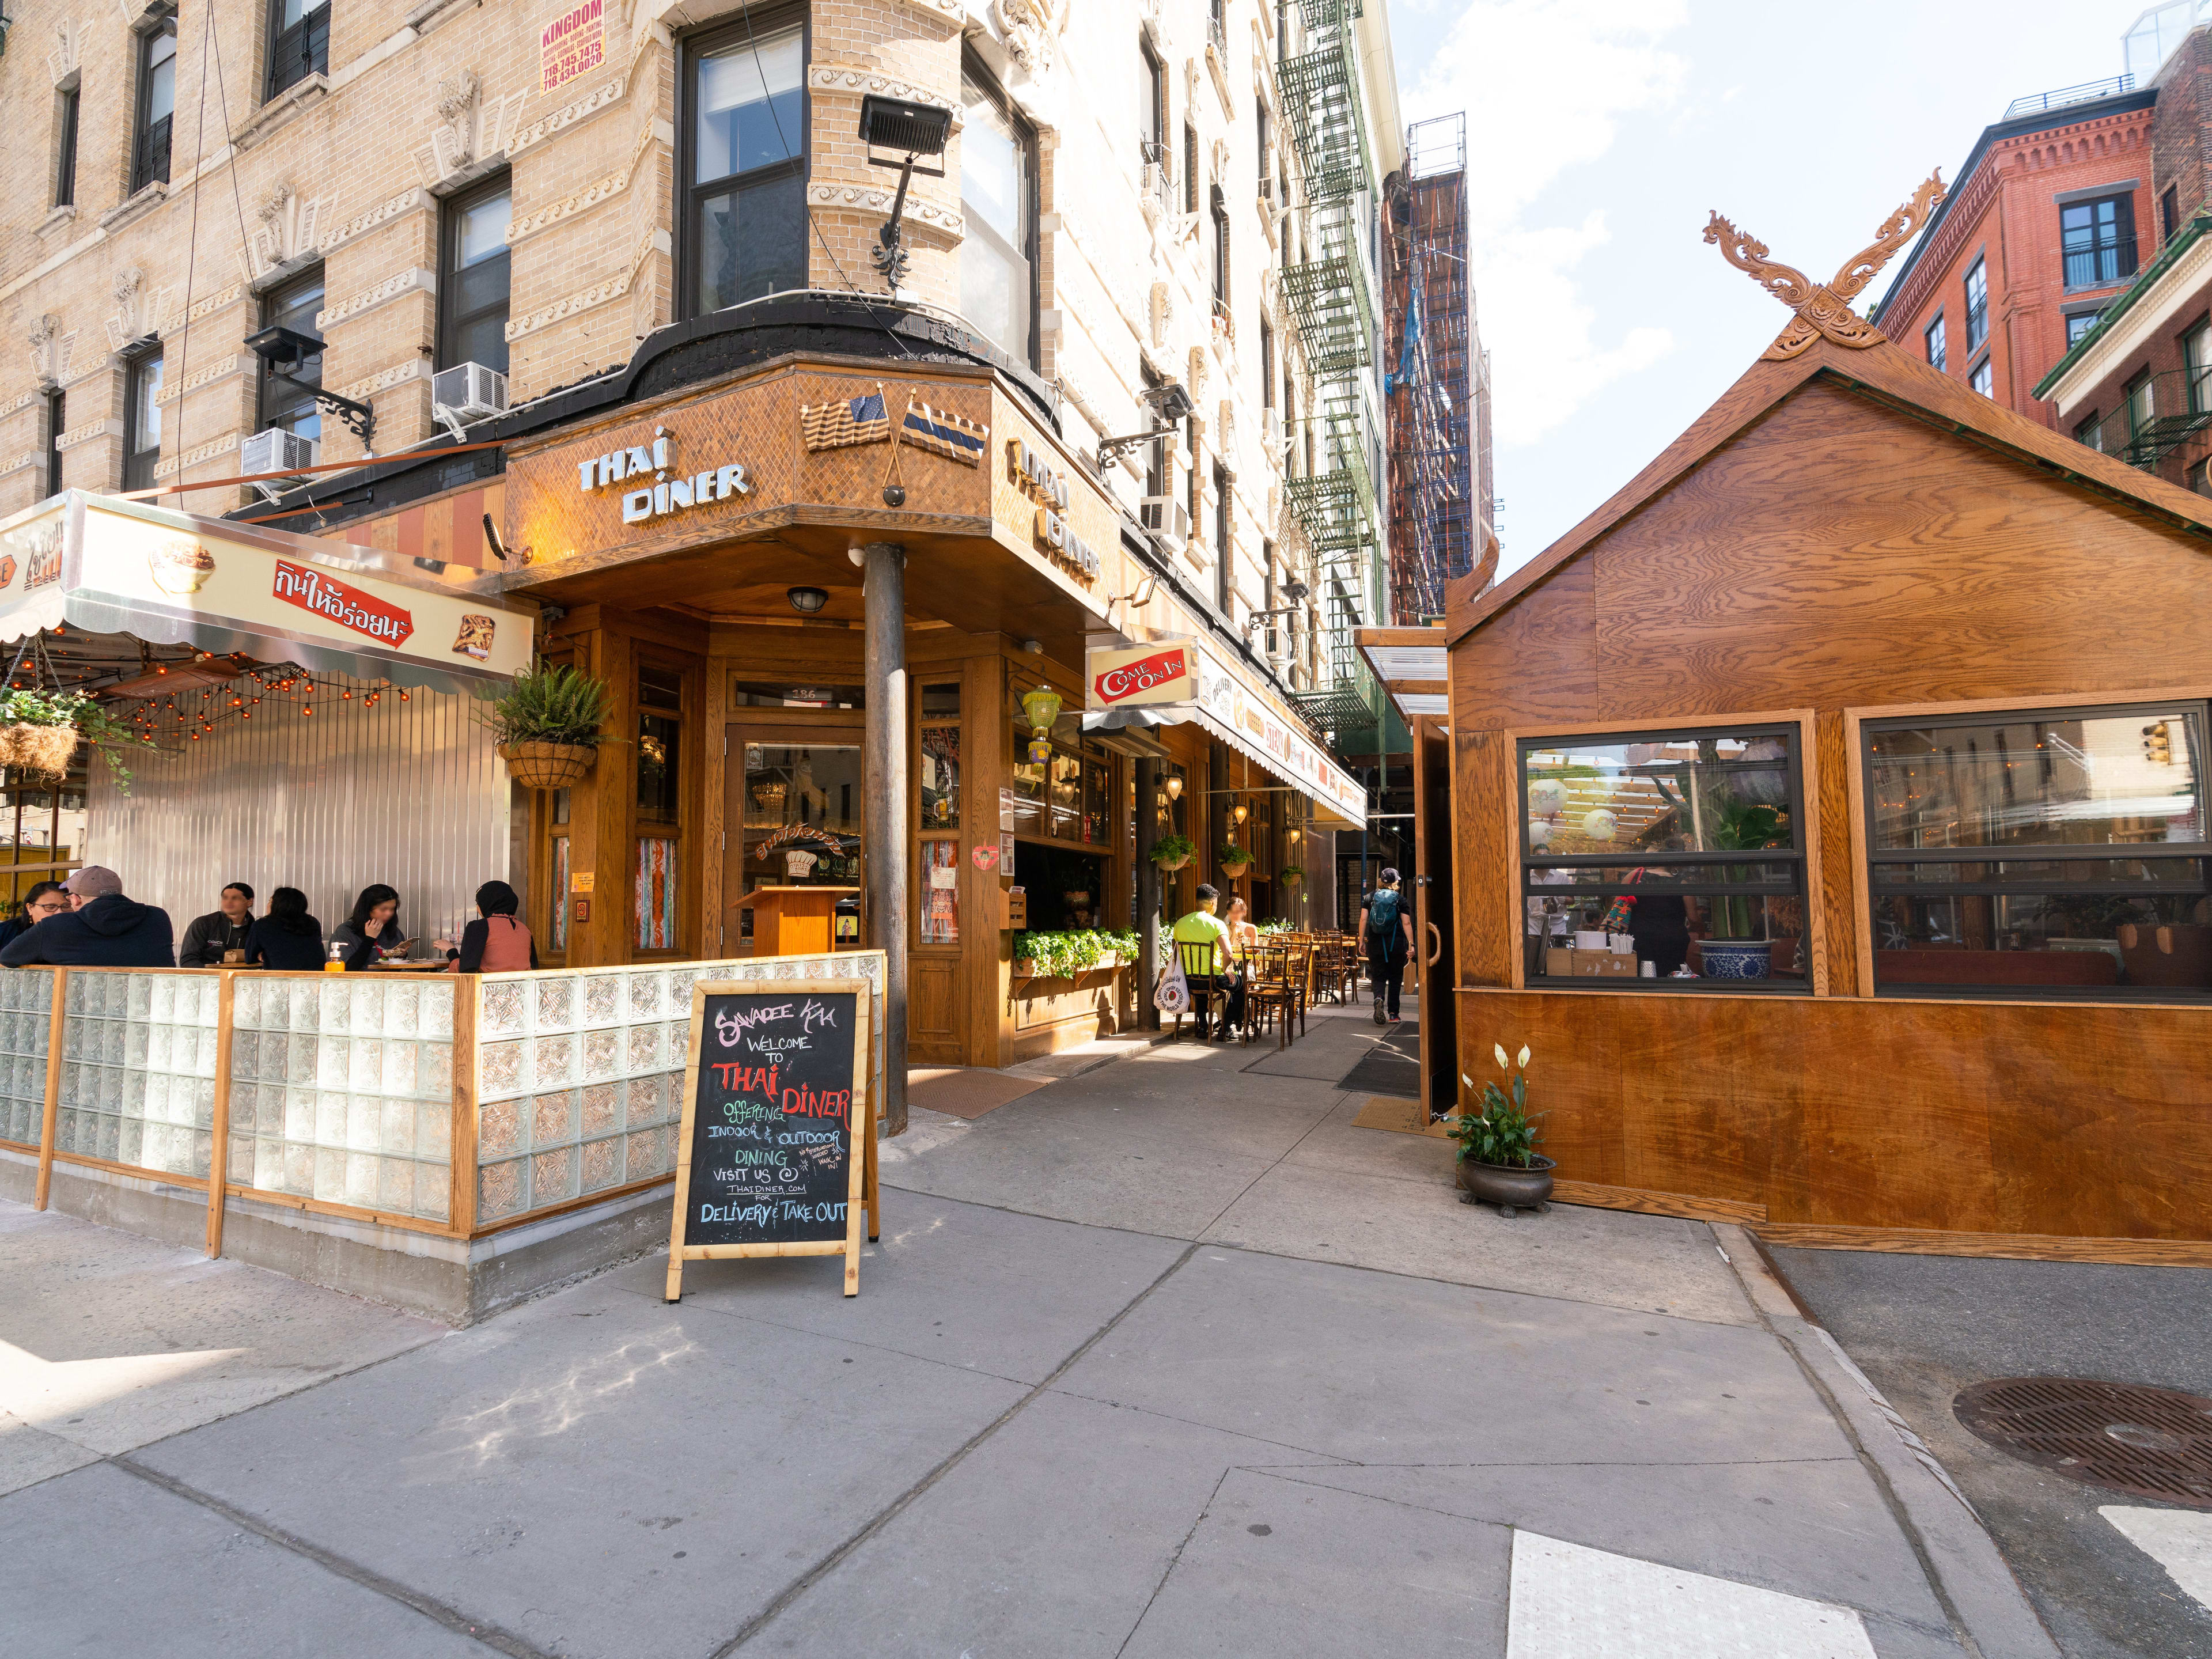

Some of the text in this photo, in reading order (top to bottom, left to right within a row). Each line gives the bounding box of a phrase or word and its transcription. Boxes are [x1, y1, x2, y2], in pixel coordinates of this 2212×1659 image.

[543, 0, 602, 48] KINGDOM
[570, 29, 584, 43] ROOFING
[586, 20, 602, 33] PAINTING
[558, 44, 575, 59] SIDEWALKS
[577, 34, 592, 49] SCAFFOLD
[592, 29, 603, 40] WORK
[544, 40, 601, 80] 718.745.7475
[544, 51, 602, 92] 718.434.0020
[275, 563, 410, 640] กินให้อร่อยนะ
[1101, 663, 1151, 696] COME
[1137, 659, 1183, 689] ON IN
[793, 690, 815, 698] 186
[1213, 677, 1232, 702] DELIVERY
[1267, 726, 1283, 756] STEAK
[715, 1003, 794, 1047] SAWADEE
[747, 1035, 812, 1052] WELCOME
[766, 1052, 783, 1063] TO
[708, 1125, 760, 1139] INDOOR
[779, 1131, 845, 1153] OUTDOOR
[736, 1149, 787, 1169] DINING
[812, 1150, 828, 1160] NEEDED
[818, 1156, 835, 1165] WALK
[713, 1168, 798, 1183] VISIT US @
[727, 1184, 806, 1194] THAIDINER.COM
[779, 1200, 813, 1221] TAKE
[816, 1202, 848, 1221] OUT
